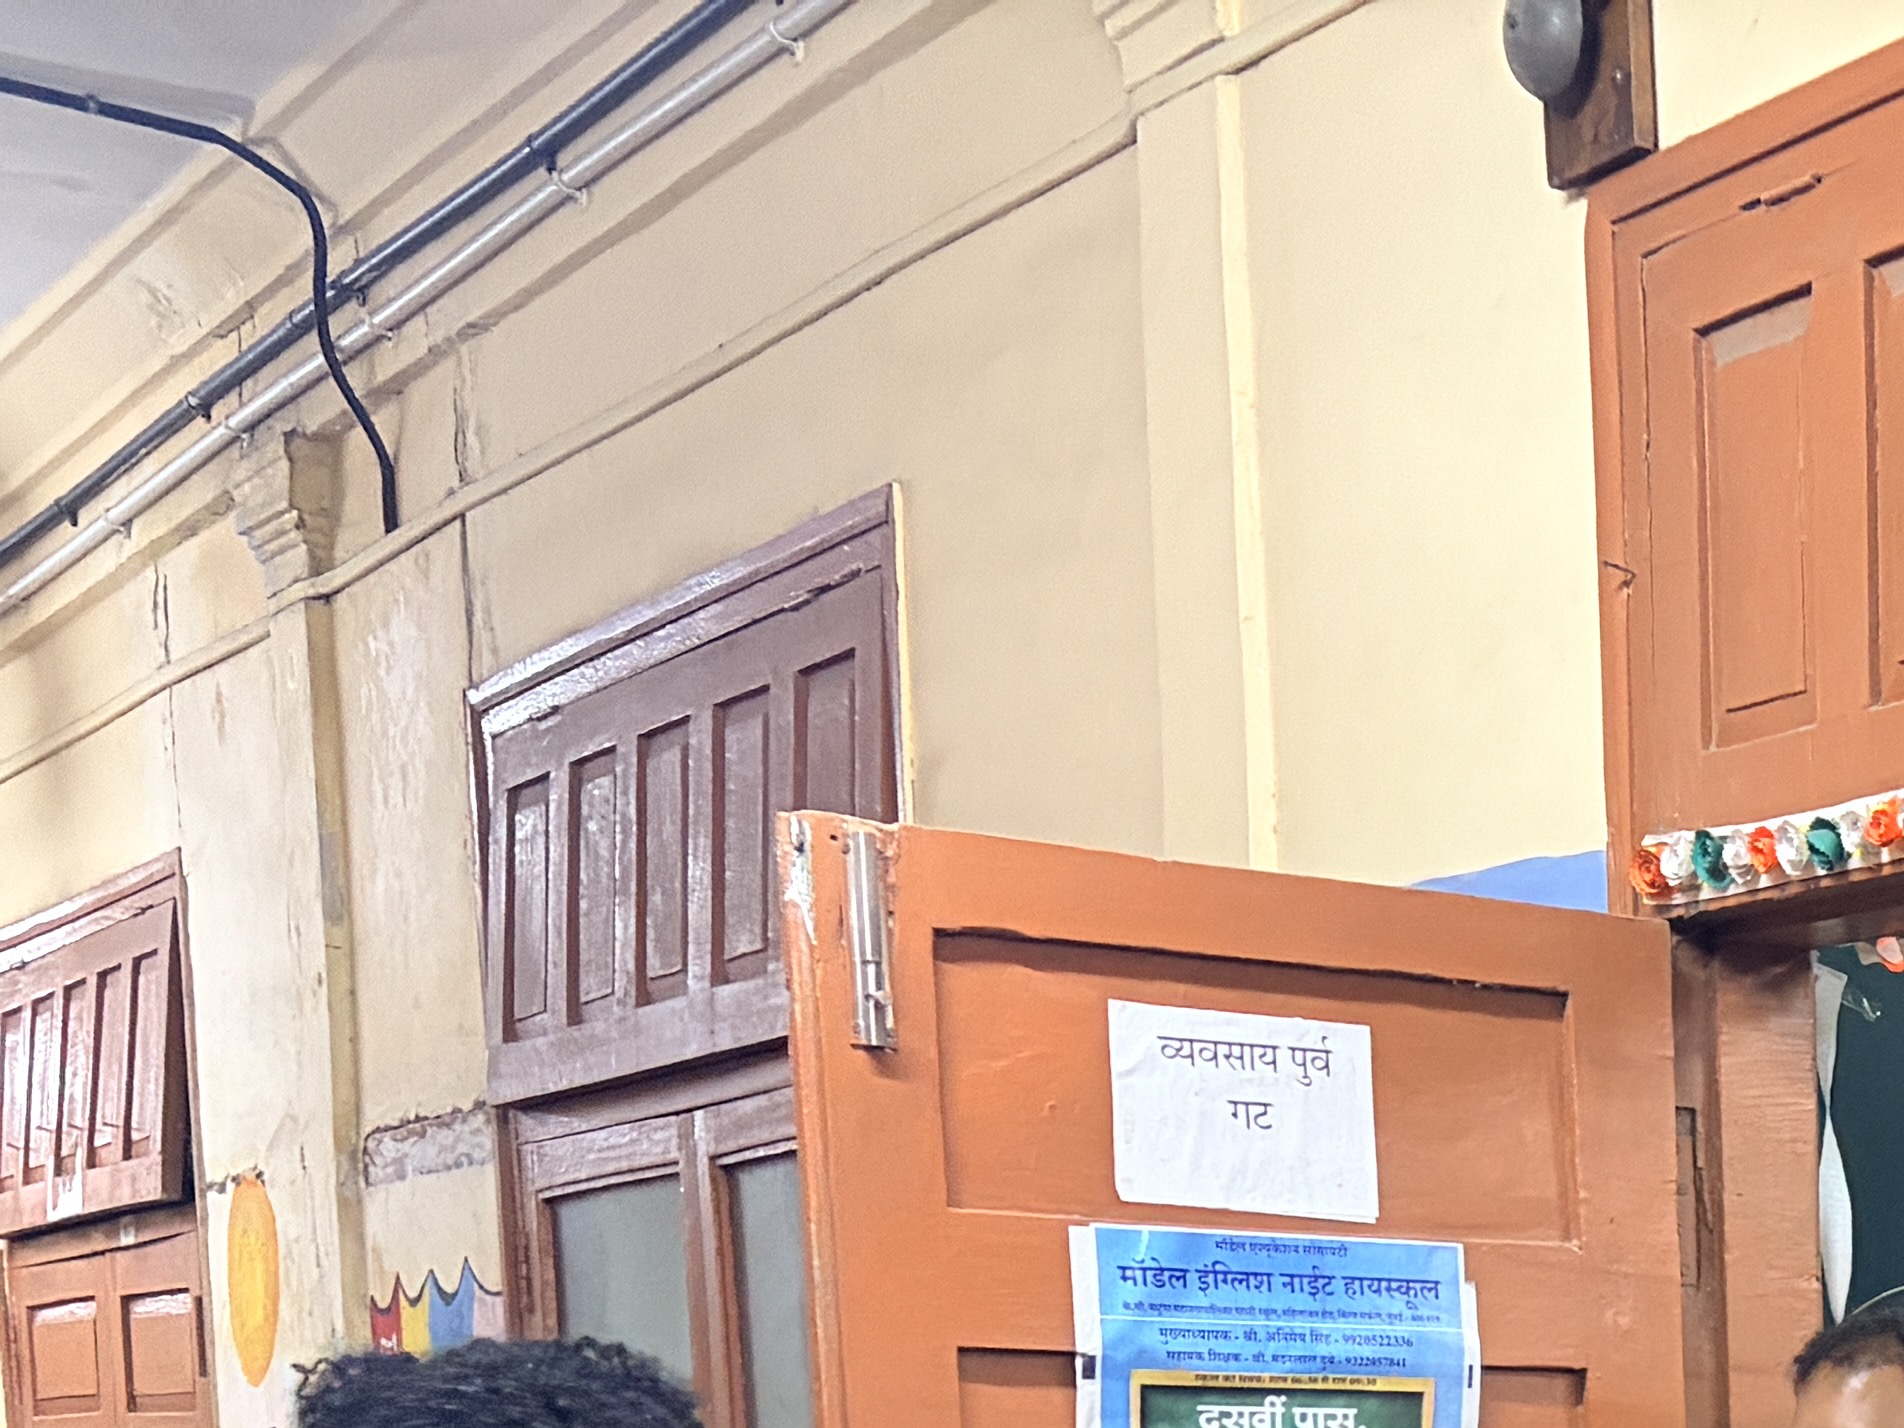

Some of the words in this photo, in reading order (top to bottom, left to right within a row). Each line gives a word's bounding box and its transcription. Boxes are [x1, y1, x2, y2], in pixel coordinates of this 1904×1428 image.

[1157, 1036, 1280, 1073] व्यवसाय
[1227, 1100, 1274, 1130] गट
[1117, 1257, 1190, 1289] मॉडेल
[1195, 1260, 1274, 1297] इंग्लिश
[1279, 1265, 1336, 1301] नाईट
[1341, 1276, 1442, 1311] हायस्कूल
